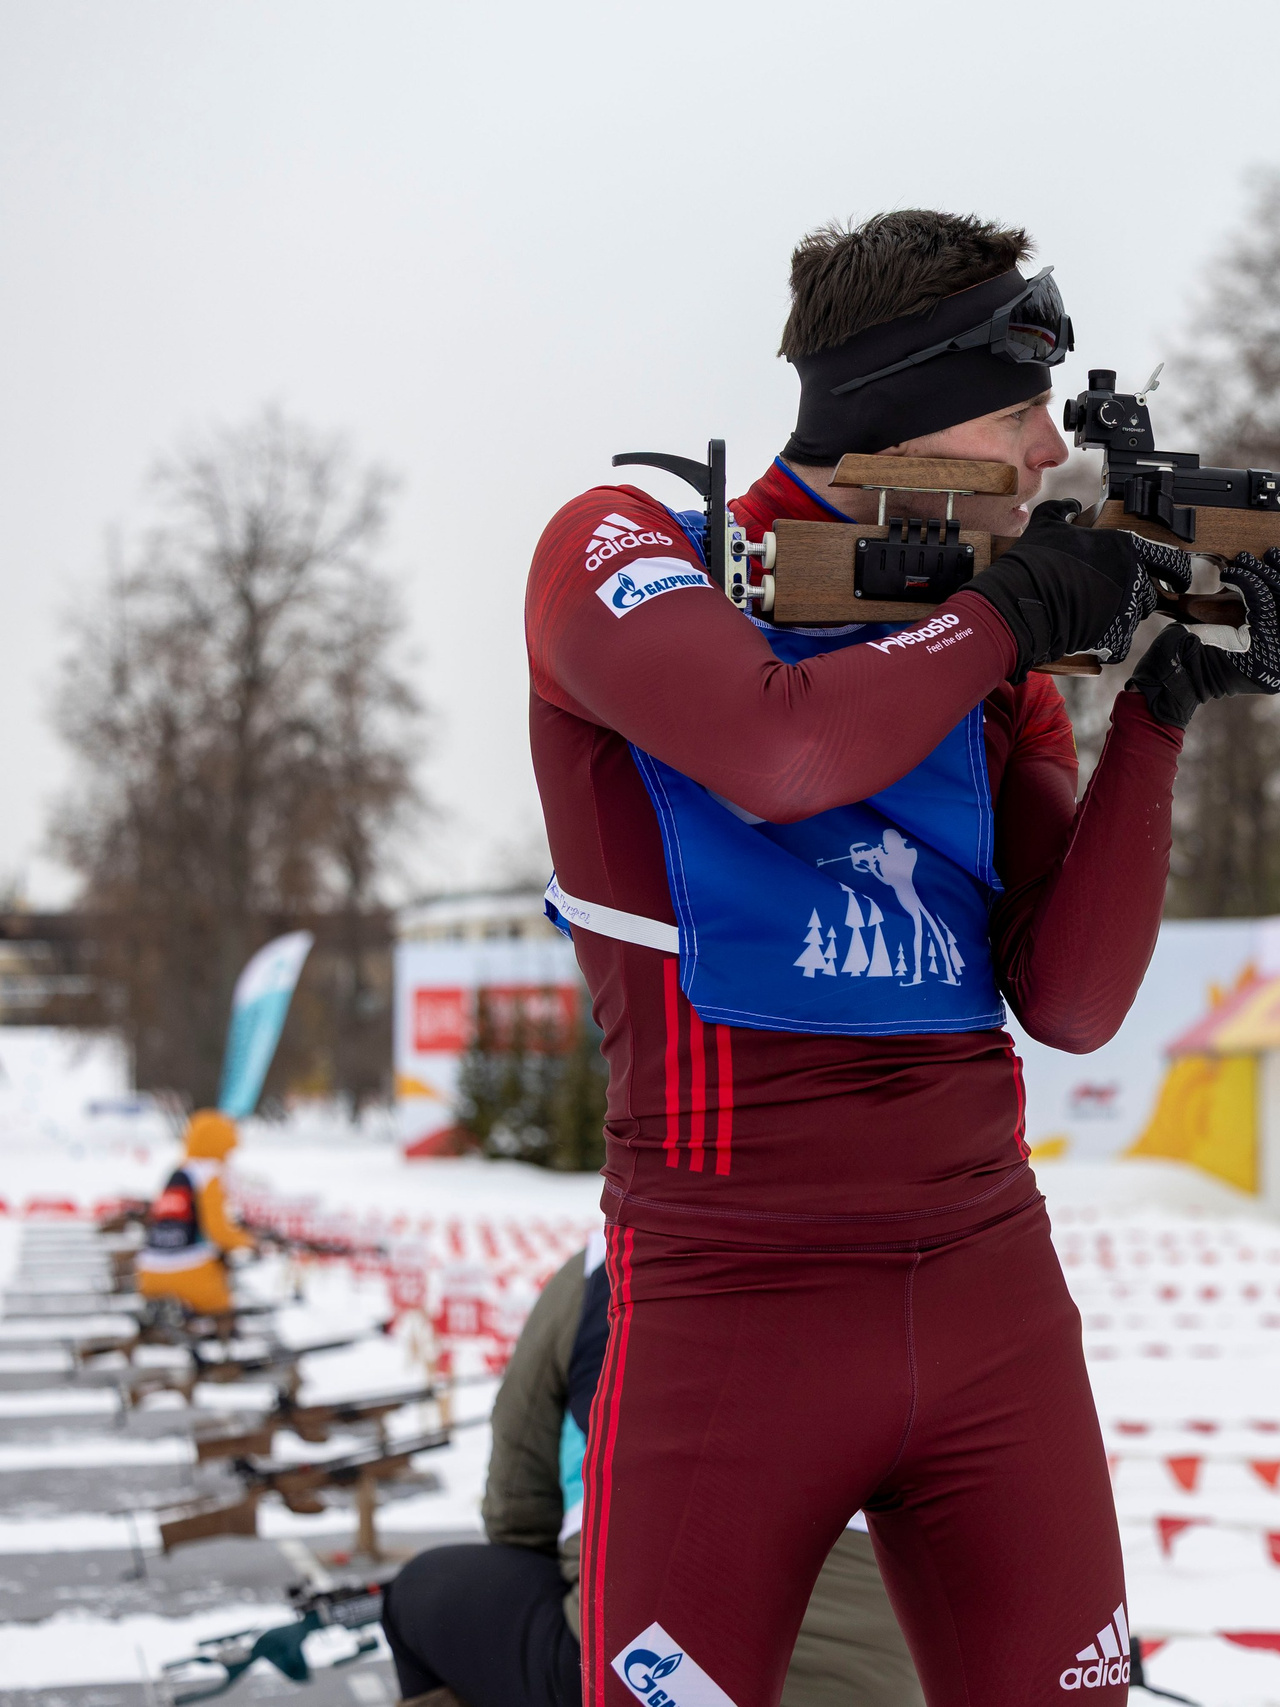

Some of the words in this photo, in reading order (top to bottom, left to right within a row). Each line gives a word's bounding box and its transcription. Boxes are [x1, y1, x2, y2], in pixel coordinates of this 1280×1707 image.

[585, 532, 673, 571] adidas
[643, 574, 708, 596] GAZPROM
[866, 613, 960, 654] Webasto
[925, 640, 944, 654] Feel
[942, 634, 956, 648] the
[955, 626, 974, 642] drive
